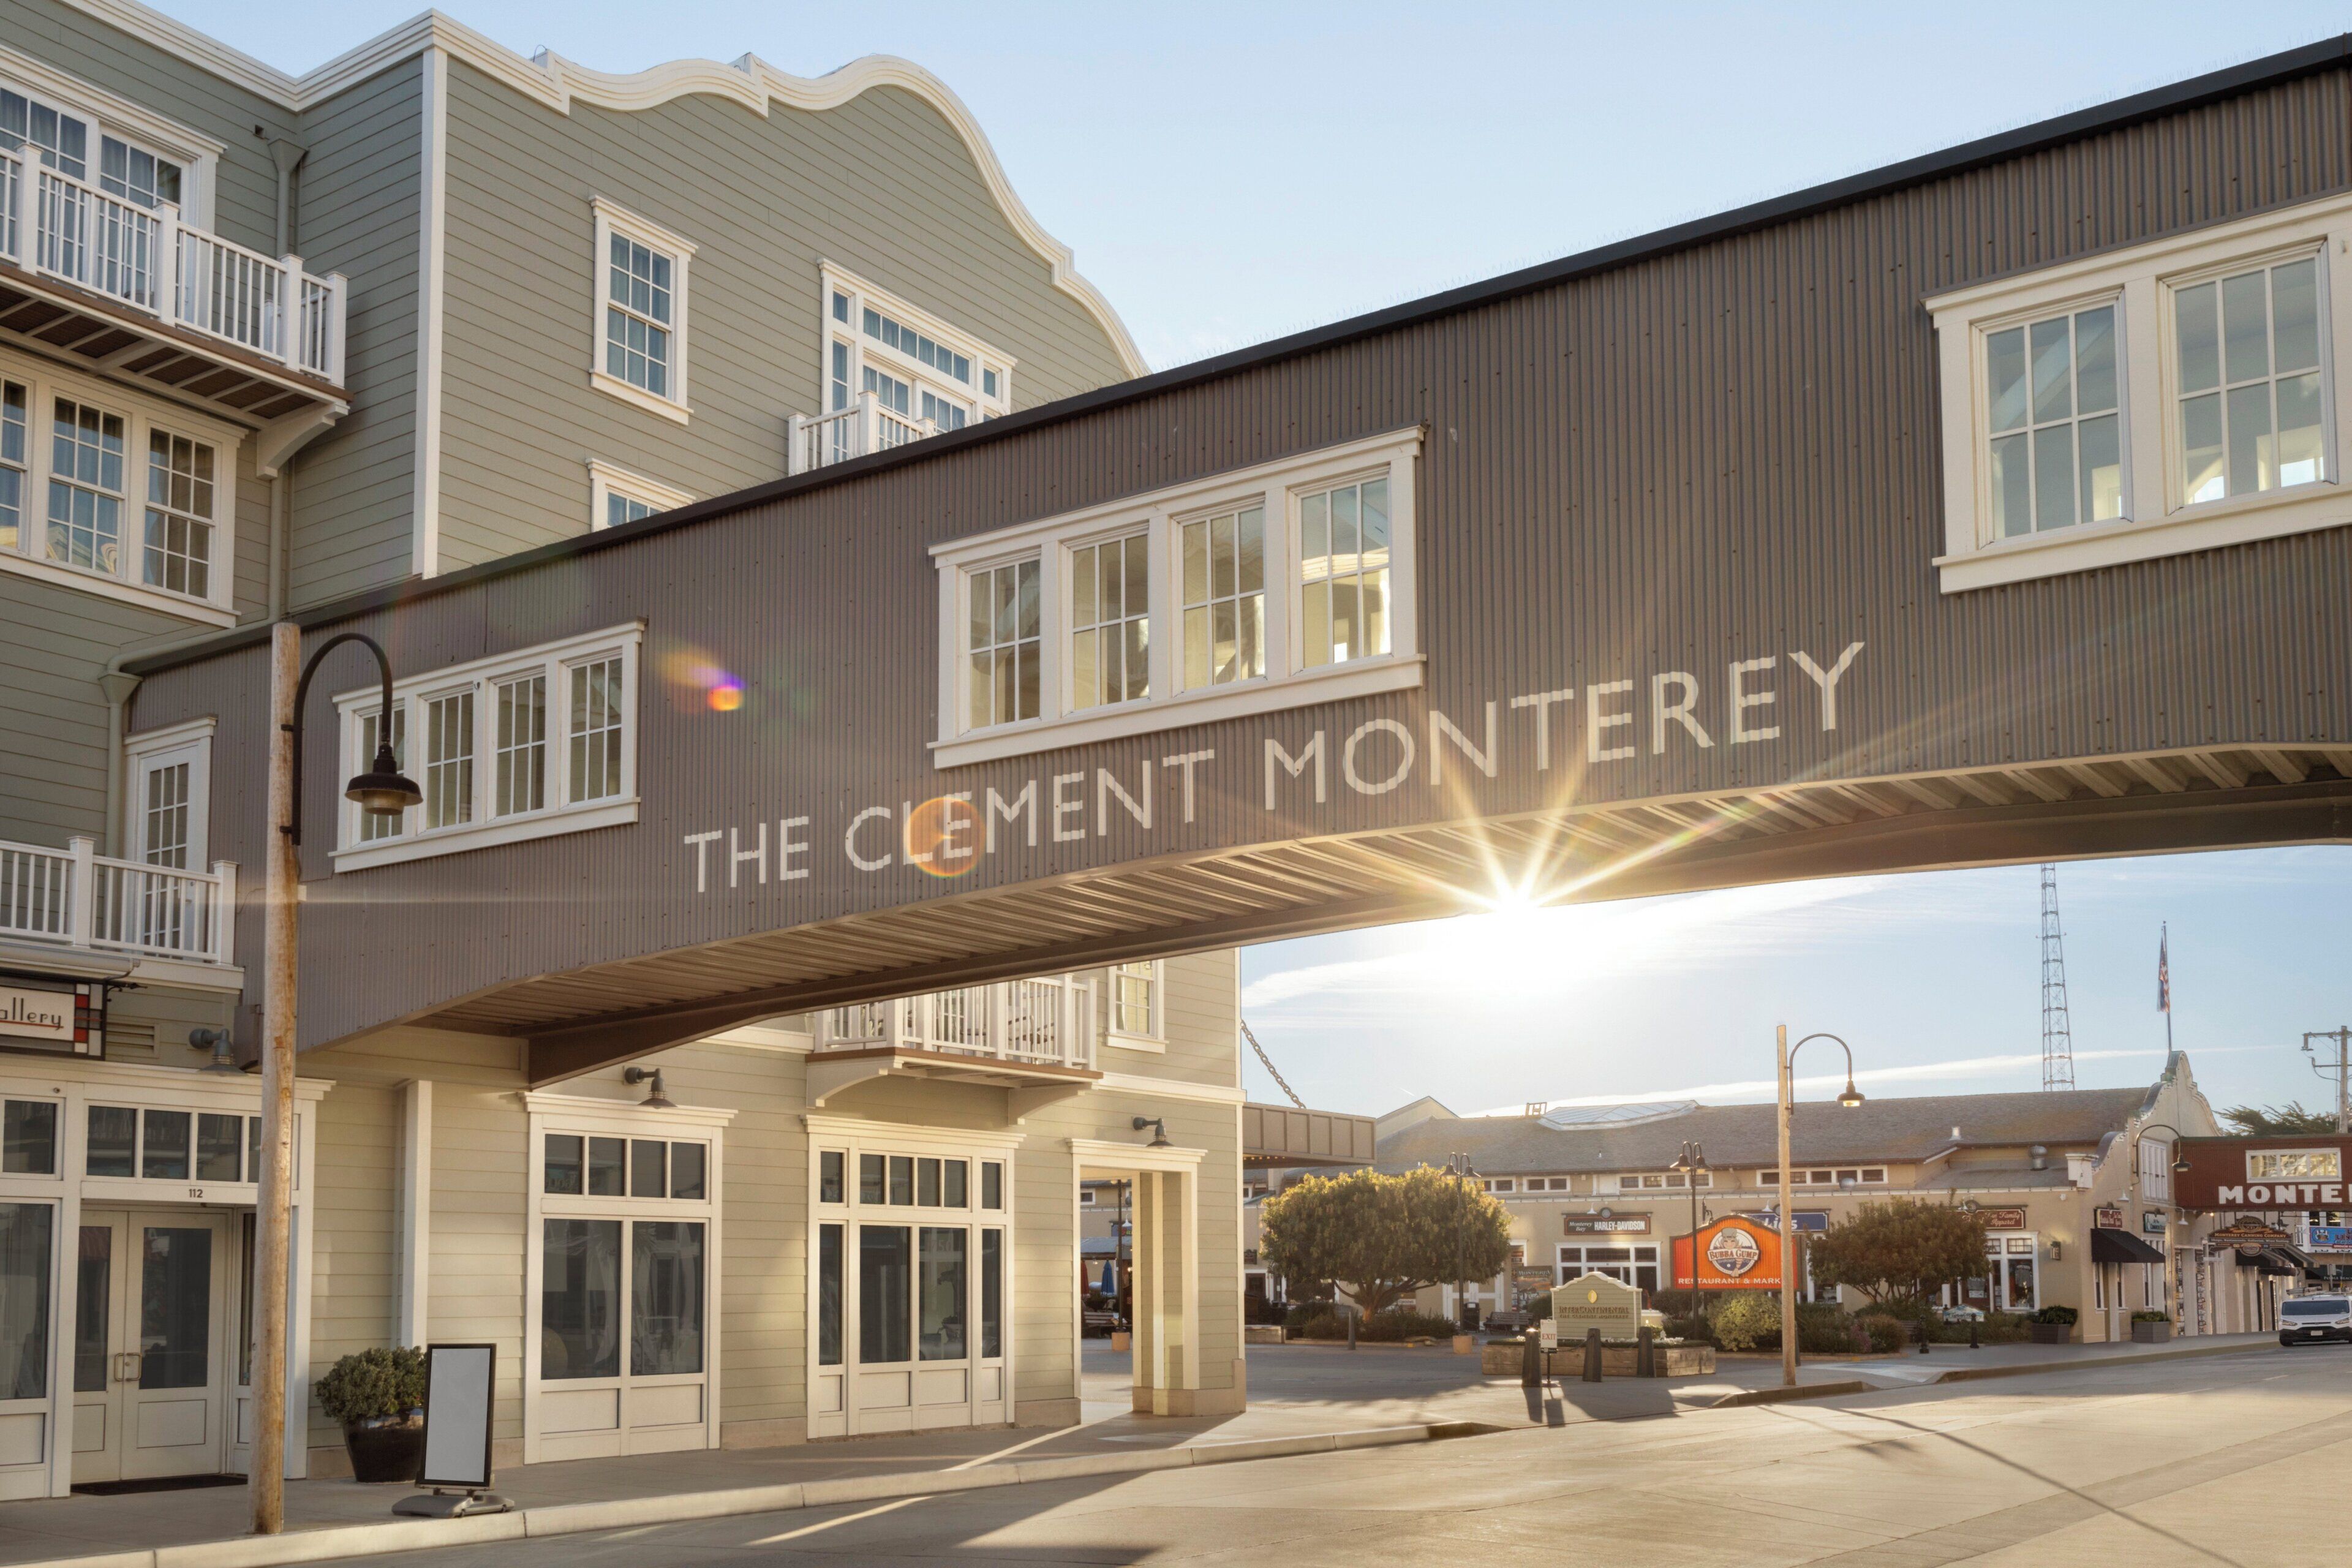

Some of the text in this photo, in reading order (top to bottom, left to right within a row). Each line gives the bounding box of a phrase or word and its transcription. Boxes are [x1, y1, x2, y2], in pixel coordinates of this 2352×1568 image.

[684, 641, 1866, 892] THE CLEMENT MONTEREY
[189, 1189, 203, 1198] 112
[2218, 1183, 2352, 1205] MONTE
[1594, 1221, 1645, 1231] HARLEY-DAVIDSON
[1990, 1218, 2015, 1227] Apparel
[1709, 1249, 1758, 1260] BUBBA GUMP
